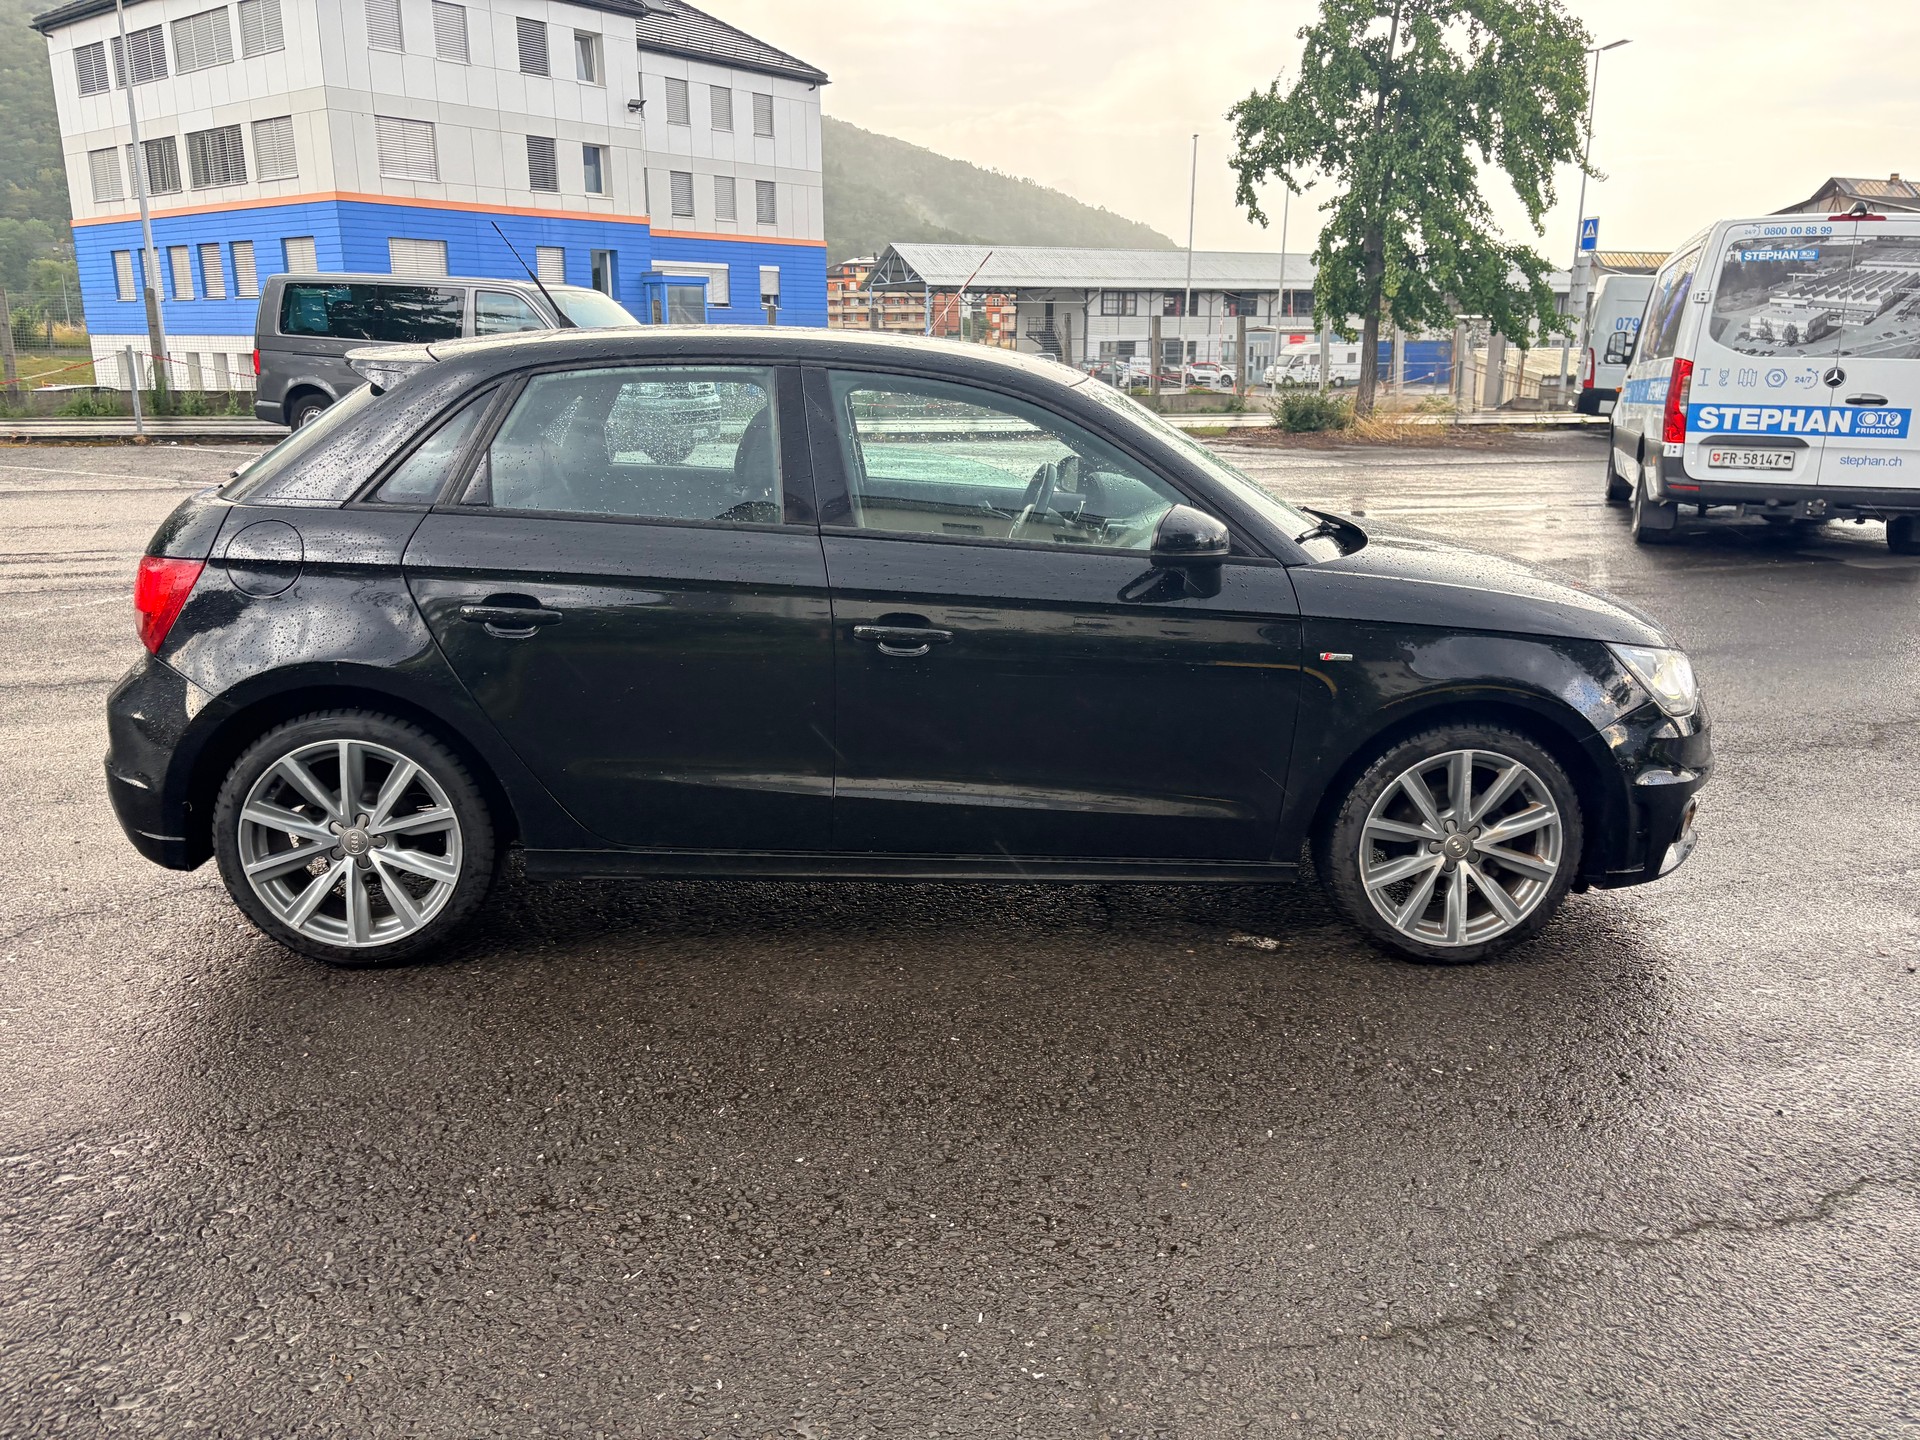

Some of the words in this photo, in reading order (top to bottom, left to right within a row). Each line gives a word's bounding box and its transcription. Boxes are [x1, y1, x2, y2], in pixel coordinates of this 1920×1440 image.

[1764, 227, 1787, 236] 0800
[1791, 226, 1802, 235] 00
[1805, 226, 1817, 235] 88
[1820, 226, 1832, 235] 99
[1744, 250, 1798, 261] STEPHAN
[1615, 317, 1640, 331] 079
[1794, 376, 1812, 384] 24/7
[1697, 406, 1853, 434] STEPHAN
[1855, 427, 1899, 435] FRIBOURG
[1840, 456, 1902, 467] stephan.ch
